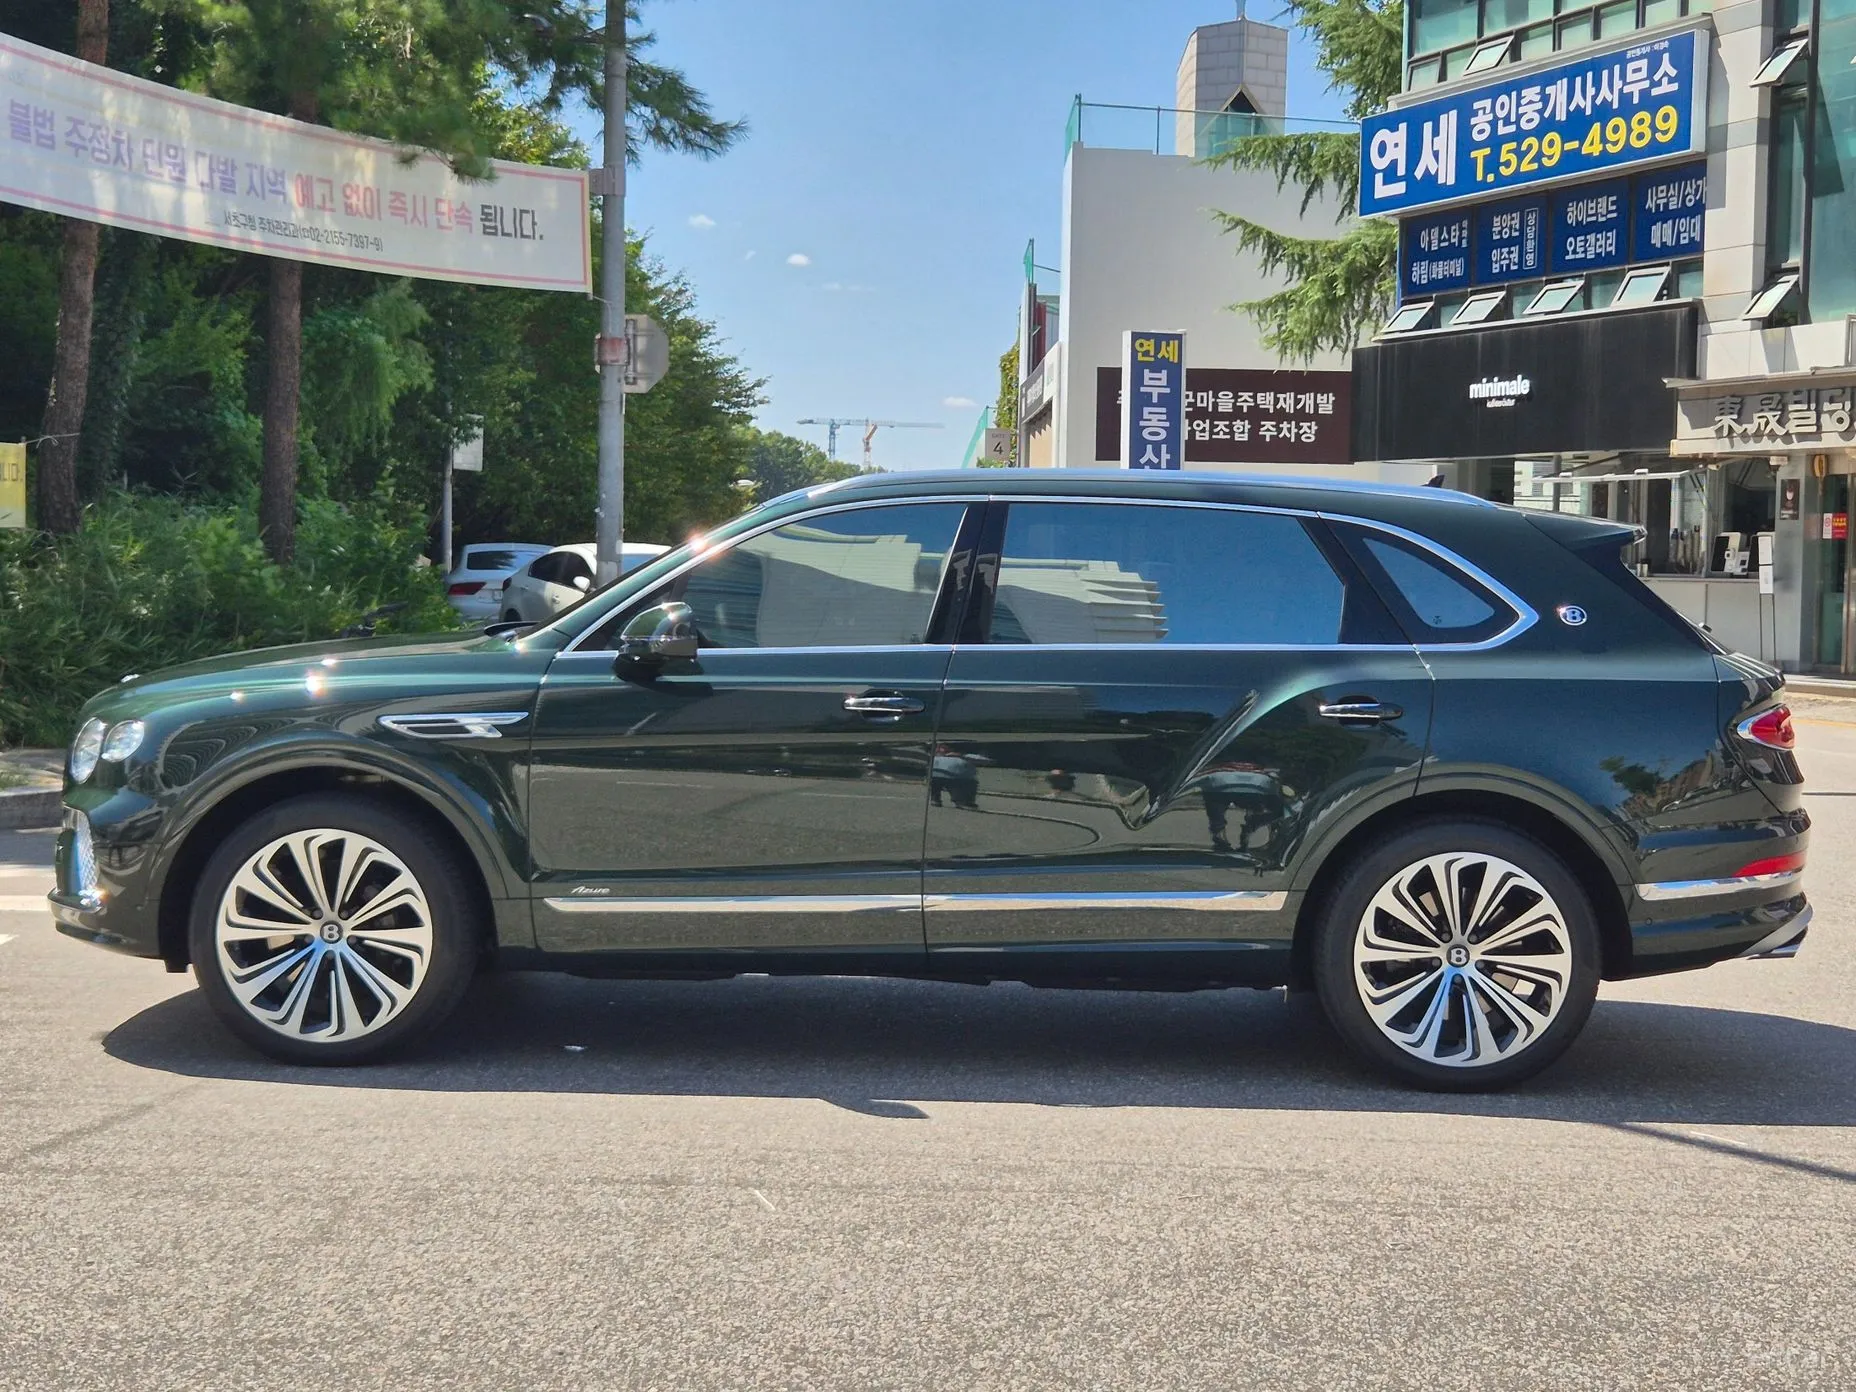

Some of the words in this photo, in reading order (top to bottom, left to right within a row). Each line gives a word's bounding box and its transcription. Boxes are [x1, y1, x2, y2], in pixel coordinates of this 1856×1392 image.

[1470, 53, 1679, 142] 공인중개사사무소
[1370, 110, 1458, 199] 연세
[1470, 104, 1679, 183] T.529-4989
[8, 99, 56, 151] 불법
[64, 115, 133, 171] 주정차
[245, 162, 288, 204] 지역
[342, 182, 382, 222] 없이
[388, 190, 430, 229] 즉시
[434, 197, 473, 234] 단속
[480, 204, 544, 242] 됩니다.
[1645, 176, 1707, 214] 사무실/상가
[1492, 211, 1520, 240] 분양권
[1566, 196, 1618, 227] 하이브랜드
[1420, 222, 1460, 252] 아델스타
[1564, 228, 1617, 260] 오토갤러리
[1650, 215, 1702, 249] 매매/임대
[1411, 260, 1429, 286] 하림
[1428, 256, 1464, 281] (화물터미널)
[1491, 245, 1519, 274] 입주권
[1134, 338, 1179, 364] 연세
[1469, 374, 1529, 399] minimale
[1258, 420, 1319, 443] 주차장
[993, 441, 1004, 455] 4
[570, 885, 611, 895] Azure
[323, 924, 340, 941] B
[1450, 947, 1467, 965] B
